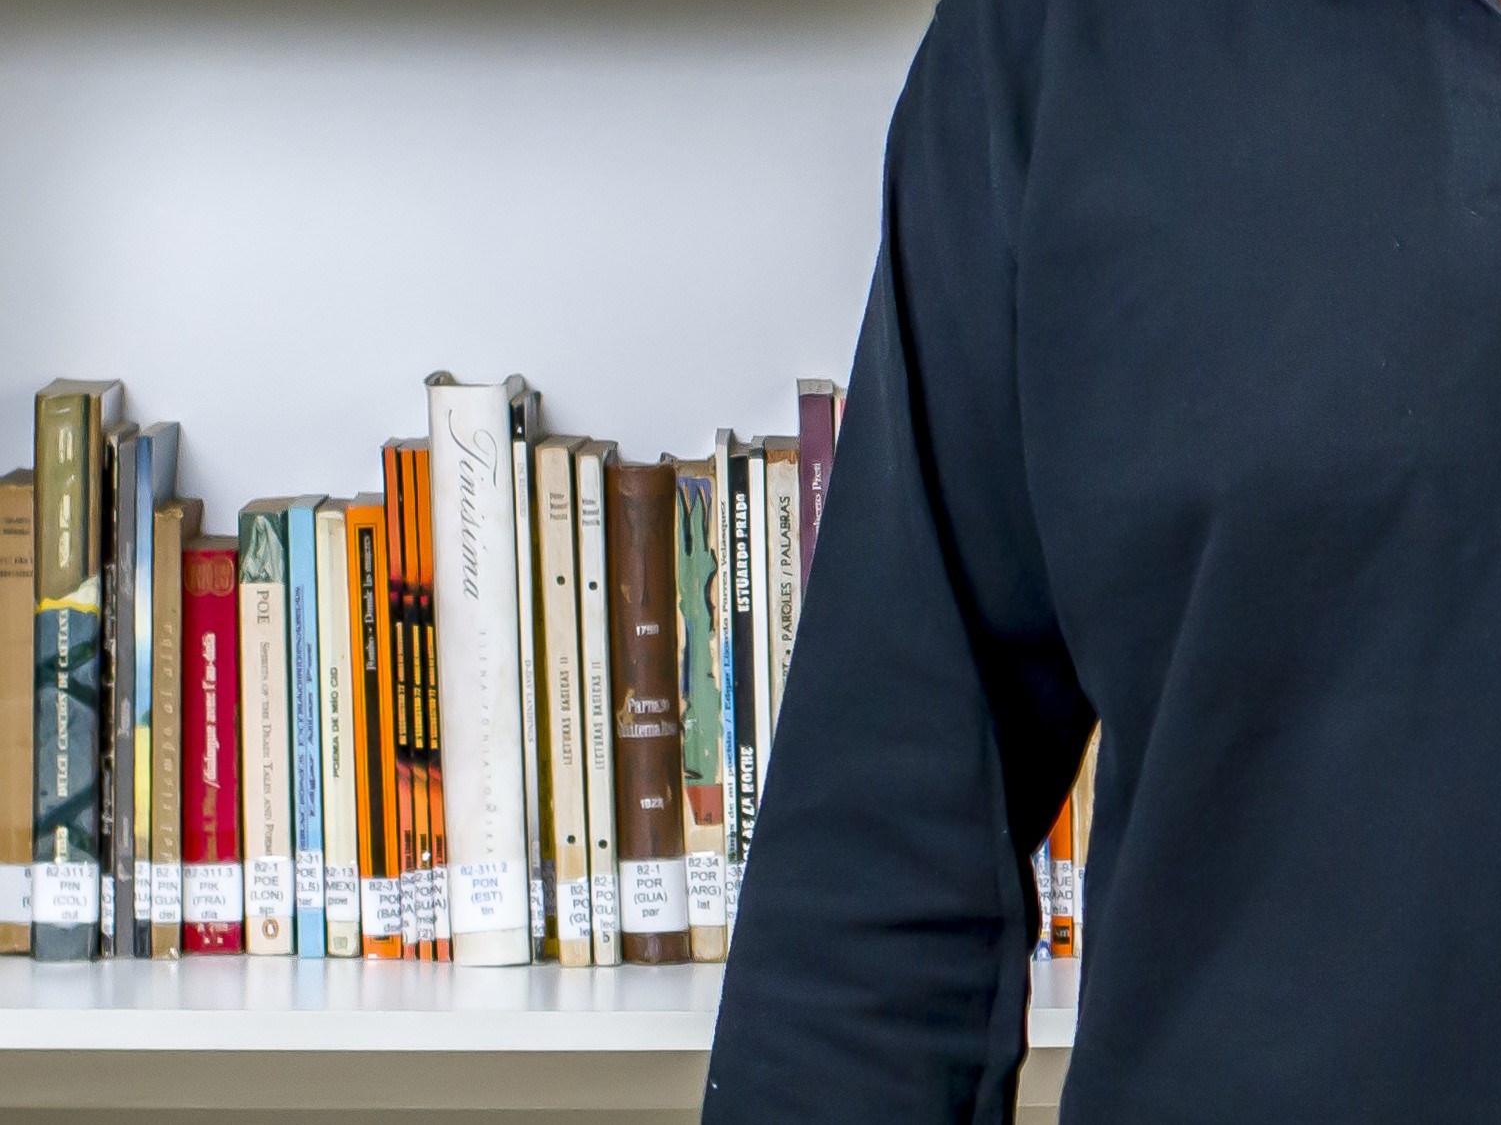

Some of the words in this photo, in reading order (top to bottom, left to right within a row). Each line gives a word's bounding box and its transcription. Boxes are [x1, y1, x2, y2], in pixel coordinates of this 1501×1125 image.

[735, 493, 749, 538] PRADO
[778, 495, 792, 567] PALABRAS
[736, 541, 751, 612] ESTUARDO
[257, 590, 270, 625] POE
[780, 581, 793, 642] PAROLES
[330, 716, 341, 732] DE
[331, 736, 341, 778] POEMA
[739, 744, 755, 794] NOCHE
[687, 857, 719, 868] 82-34
[636, 865, 661, 875] 82-1
[690, 871, 717, 882] POR
[253, 876, 279, 886] POE
[472, 878, 499, 889] PON
[636, 878, 663, 889] POR
[470, 890, 503, 903] (EST)
[685, 884, 722, 897] (ARG)
[192, 895, 226, 906] (FRA)
[633, 891, 668, 905] (GUA)
[642, 907, 660, 920] par
